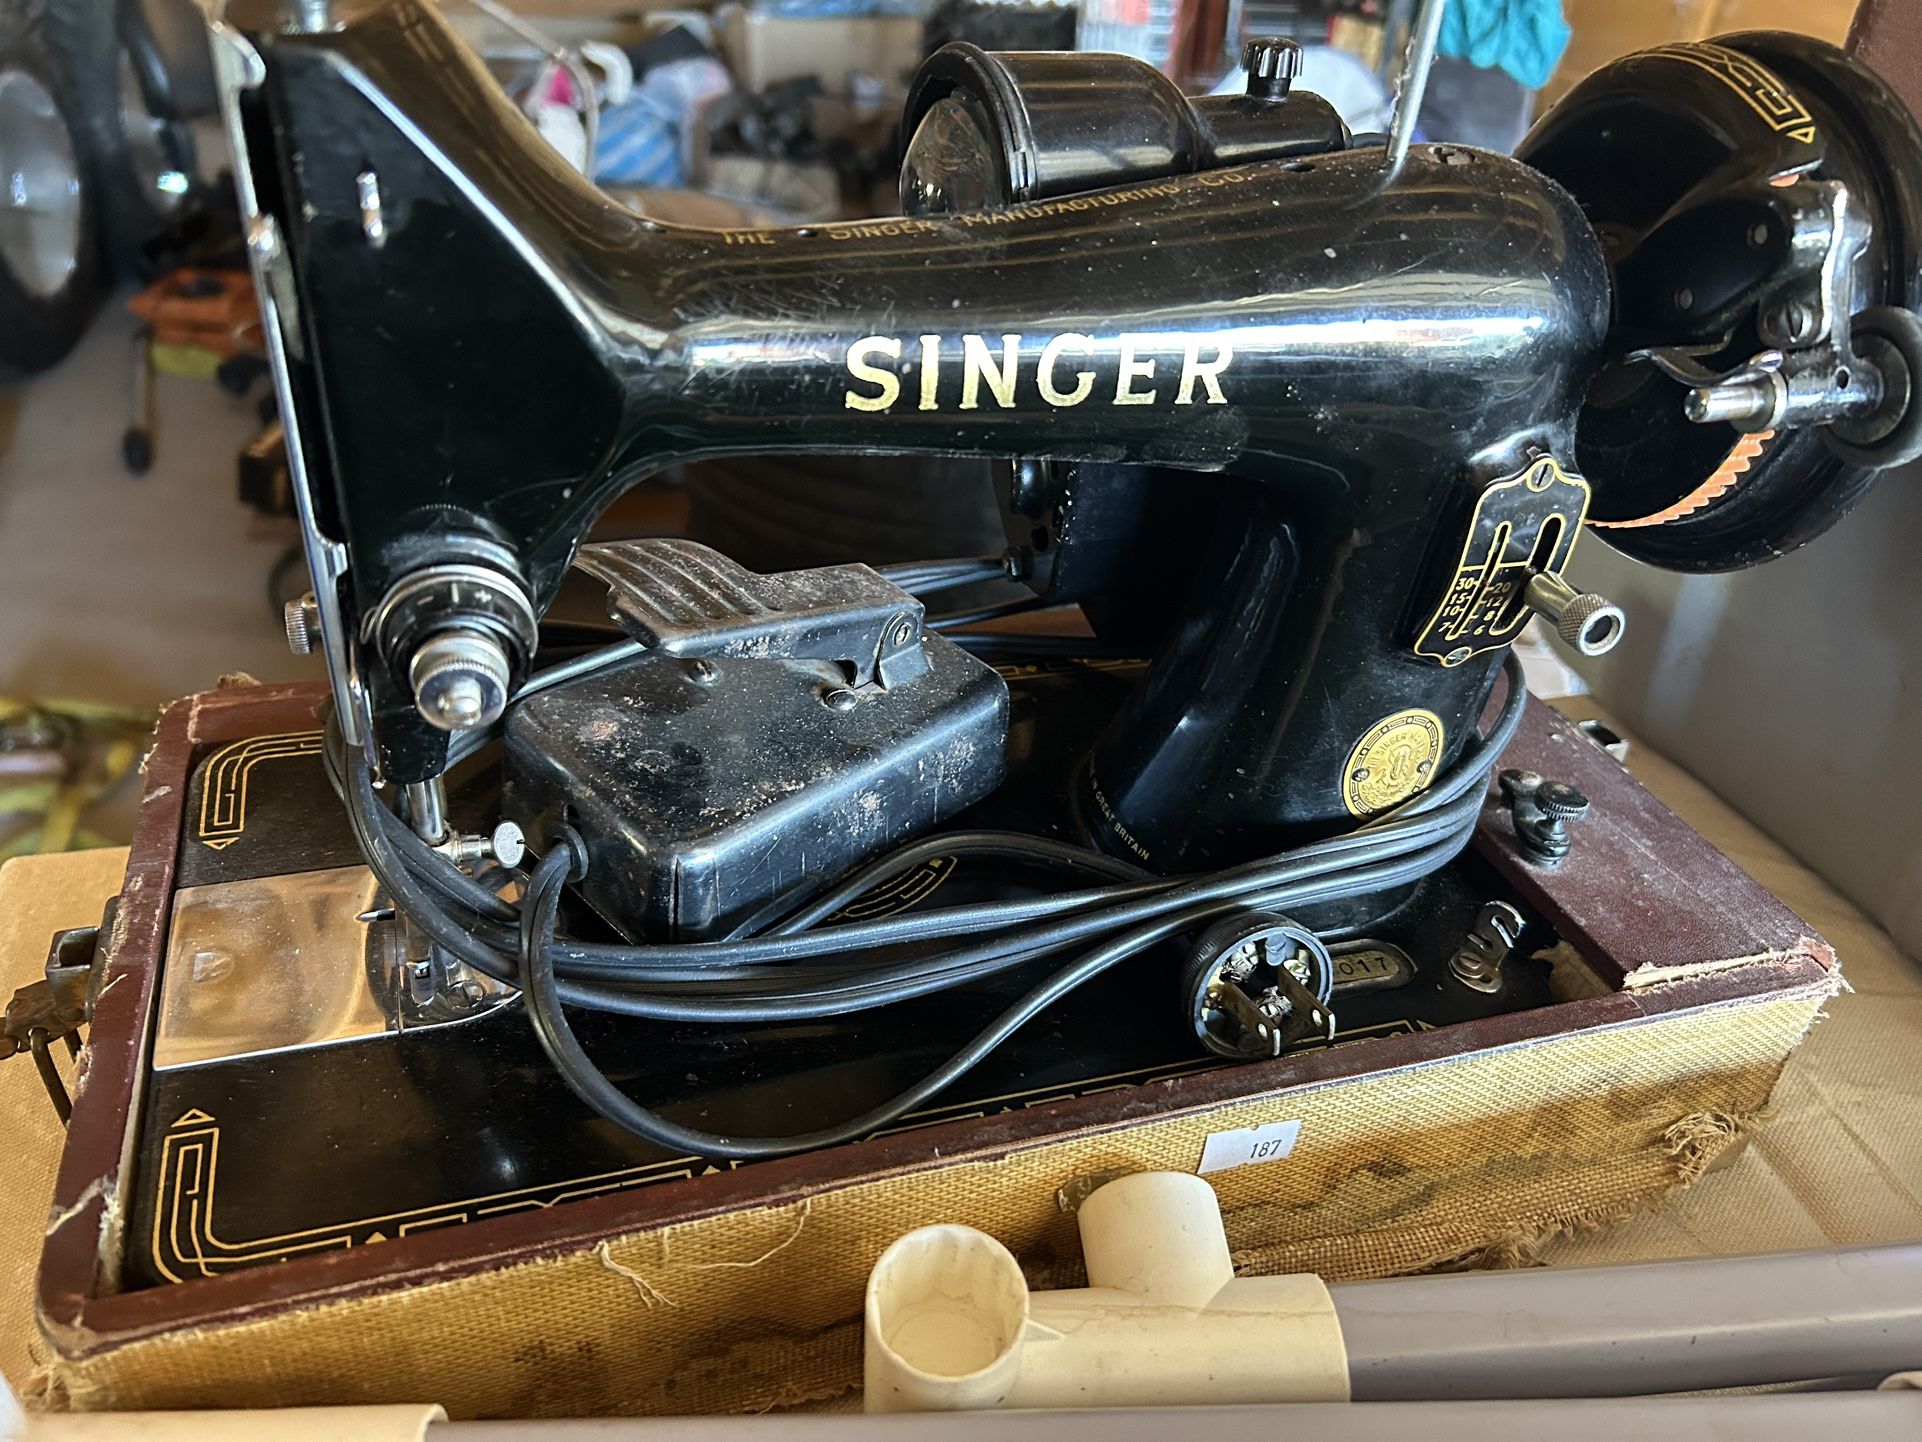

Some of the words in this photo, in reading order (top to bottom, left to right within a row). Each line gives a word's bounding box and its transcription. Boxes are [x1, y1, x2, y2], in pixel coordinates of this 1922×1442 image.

[723, 231, 776, 245] THE
[828, 219, 938, 240] SINGER
[960, 184, 1181, 227] MANUFACTURING
[845, 331, 1234, 411] SINGER
[1455, 577, 1475, 591] 30
[1492, 581, 1511, 594] 20
[1449, 592, 1468, 605] 15
[1486, 596, 1503, 608] 12
[1442, 605, 1460, 617] 10
[1483, 611, 1495, 621] 8
[1438, 622, 1451, 632] 7
[1473, 625, 1485, 636] 6
[1095, 791, 1115, 822] GREAT
[1114, 822, 1150, 860] BRITAIN
[1250, 1139, 1282, 1159] 187
